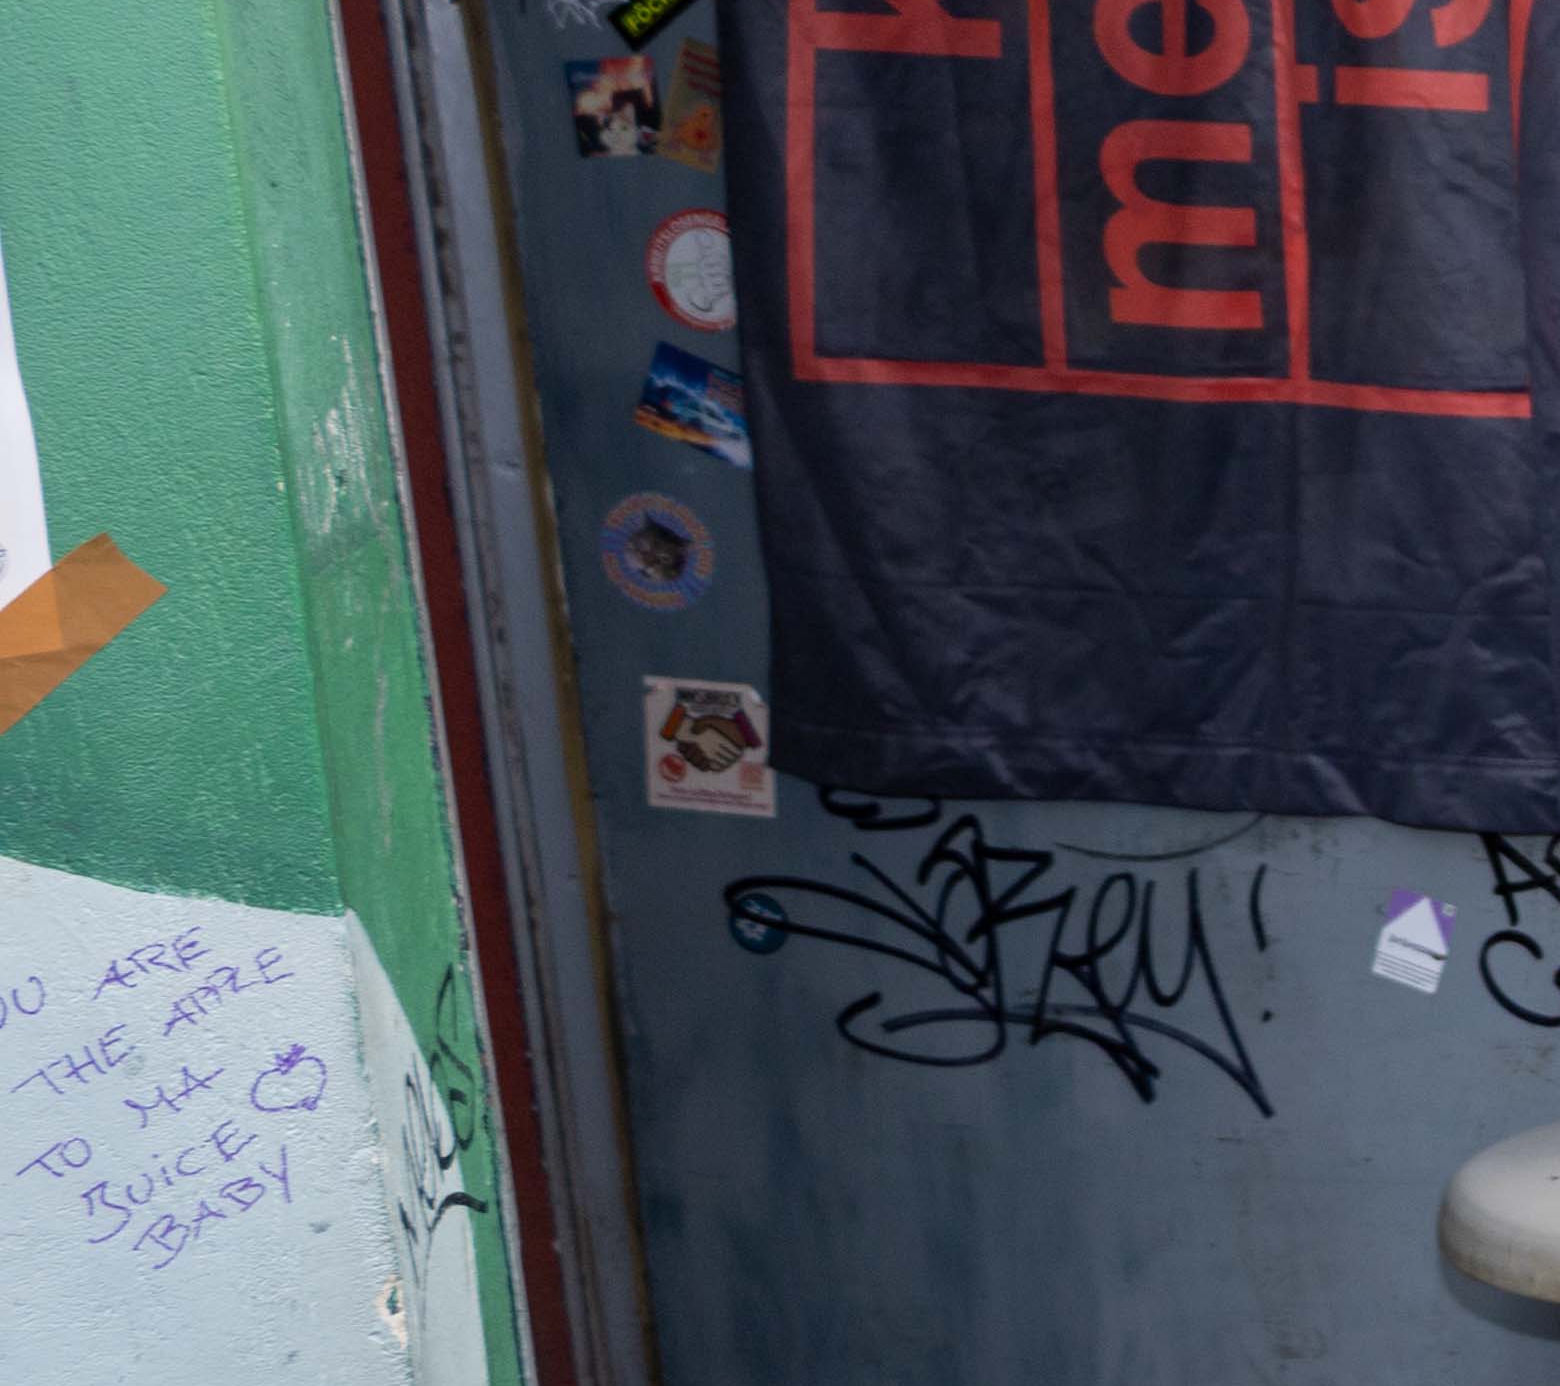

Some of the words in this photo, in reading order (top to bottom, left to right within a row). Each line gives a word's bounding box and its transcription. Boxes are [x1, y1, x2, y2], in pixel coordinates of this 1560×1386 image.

[92, 925, 213, 1001] ARE
[10, 1023, 136, 1096] THE
[15, 1137, 93, 1178] TO
[122, 1065, 225, 1129] MA
[132, 1143, 293, 1271] BABY
